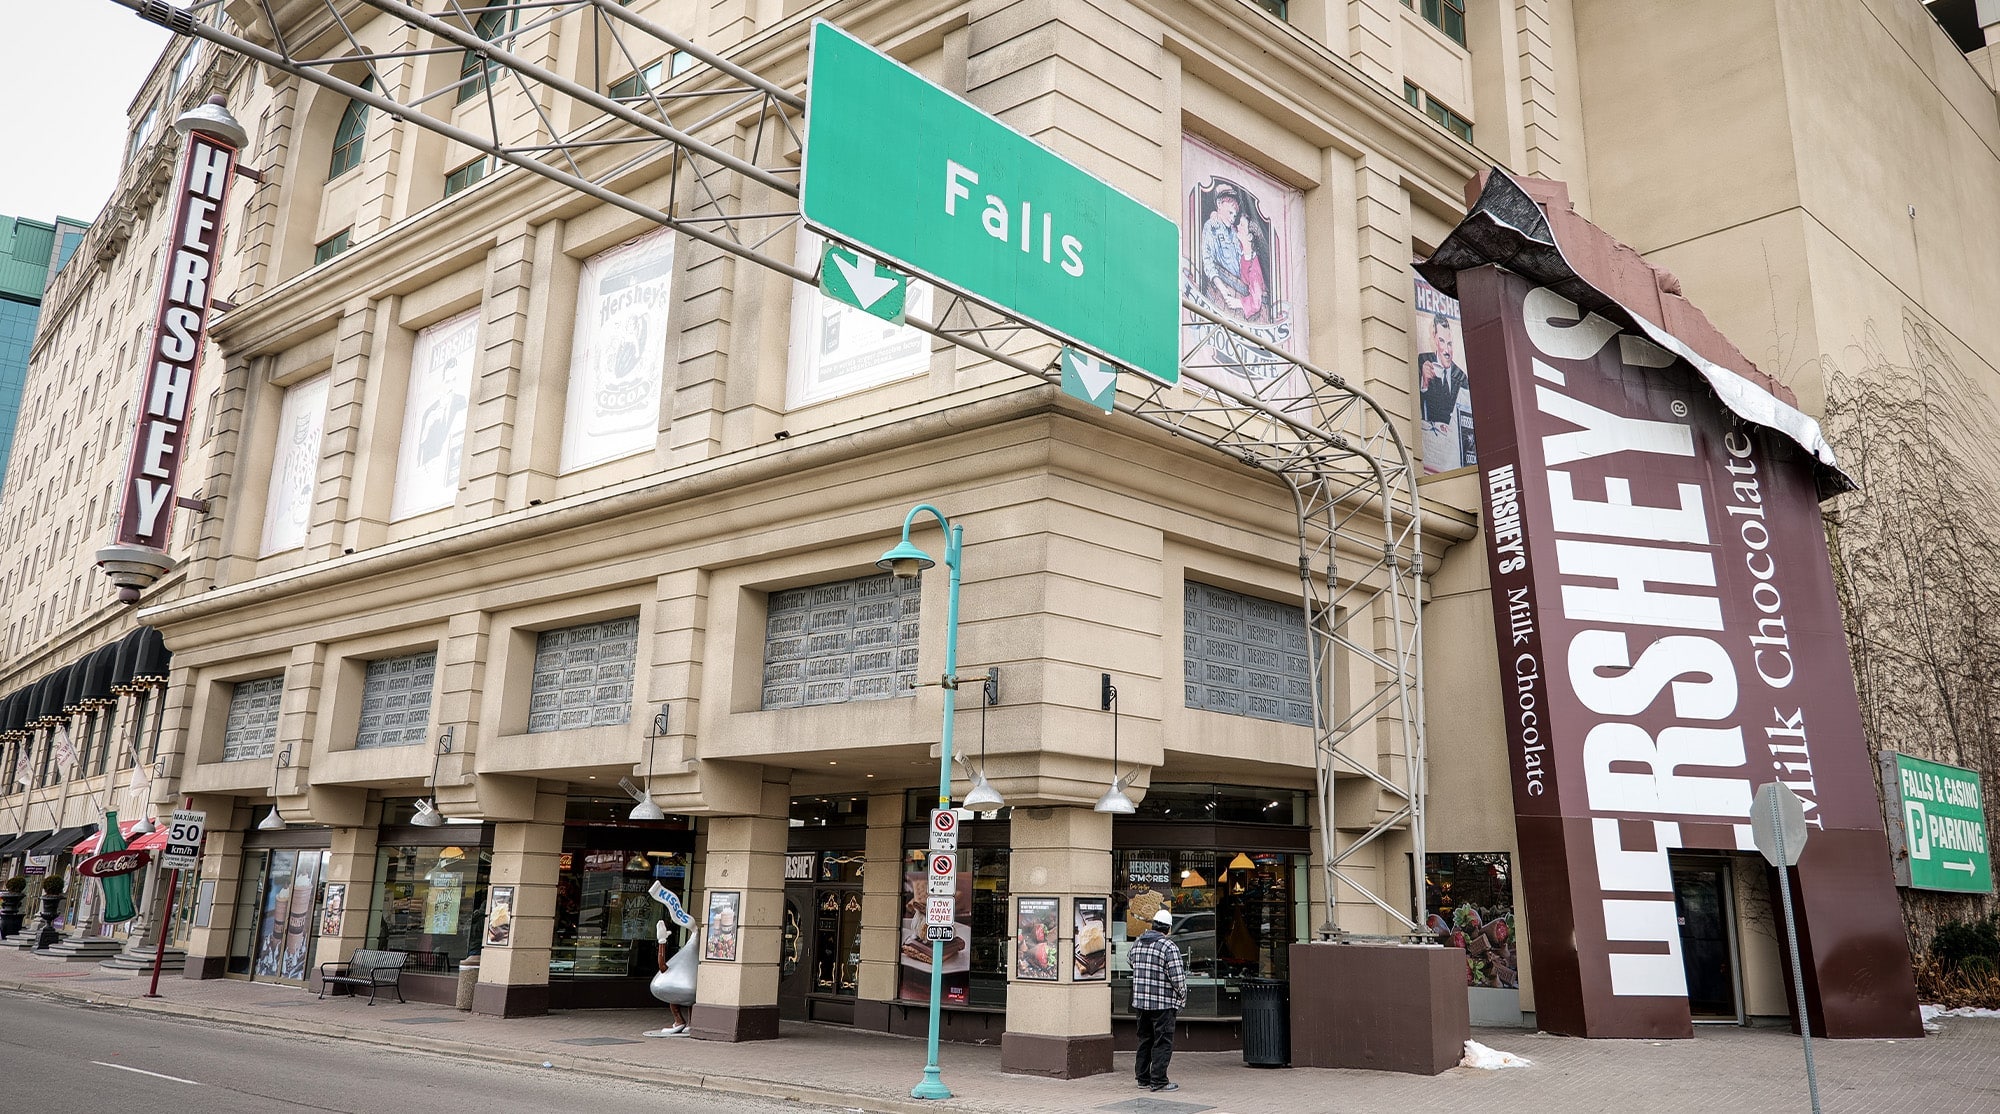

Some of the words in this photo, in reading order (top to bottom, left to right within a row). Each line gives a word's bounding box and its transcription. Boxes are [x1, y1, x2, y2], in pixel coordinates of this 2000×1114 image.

[946, 159, 1084, 277] Falls
[600, 283, 667, 328] Hershey's
[1417, 286, 1460, 318] HERSHE
[135, 143, 229, 537] HERSHEY
[600, 386, 646, 407] COCOA
[1487, 463, 1526, 576] HERSHEY'S
[1723, 432, 1795, 690] Chocolate
[1507, 585, 1536, 648] Milk
[1515, 653, 1547, 797] Chocolate
[1901, 768, 1934, 802] FALLS
[1934, 775, 1945, 803] &
[1944, 777, 1979, 810] CASINO
[171, 823, 200, 842] 50
[174, 813, 204, 822] MAXIMUM
[1928, 814, 1985, 854] PARKING
[170, 845, 193, 855] km/h
[785, 856, 816, 879] RSHEY
[1129, 861, 1170, 875] HERSHEY'S
[1129, 874, 1170, 883] S'MORES
